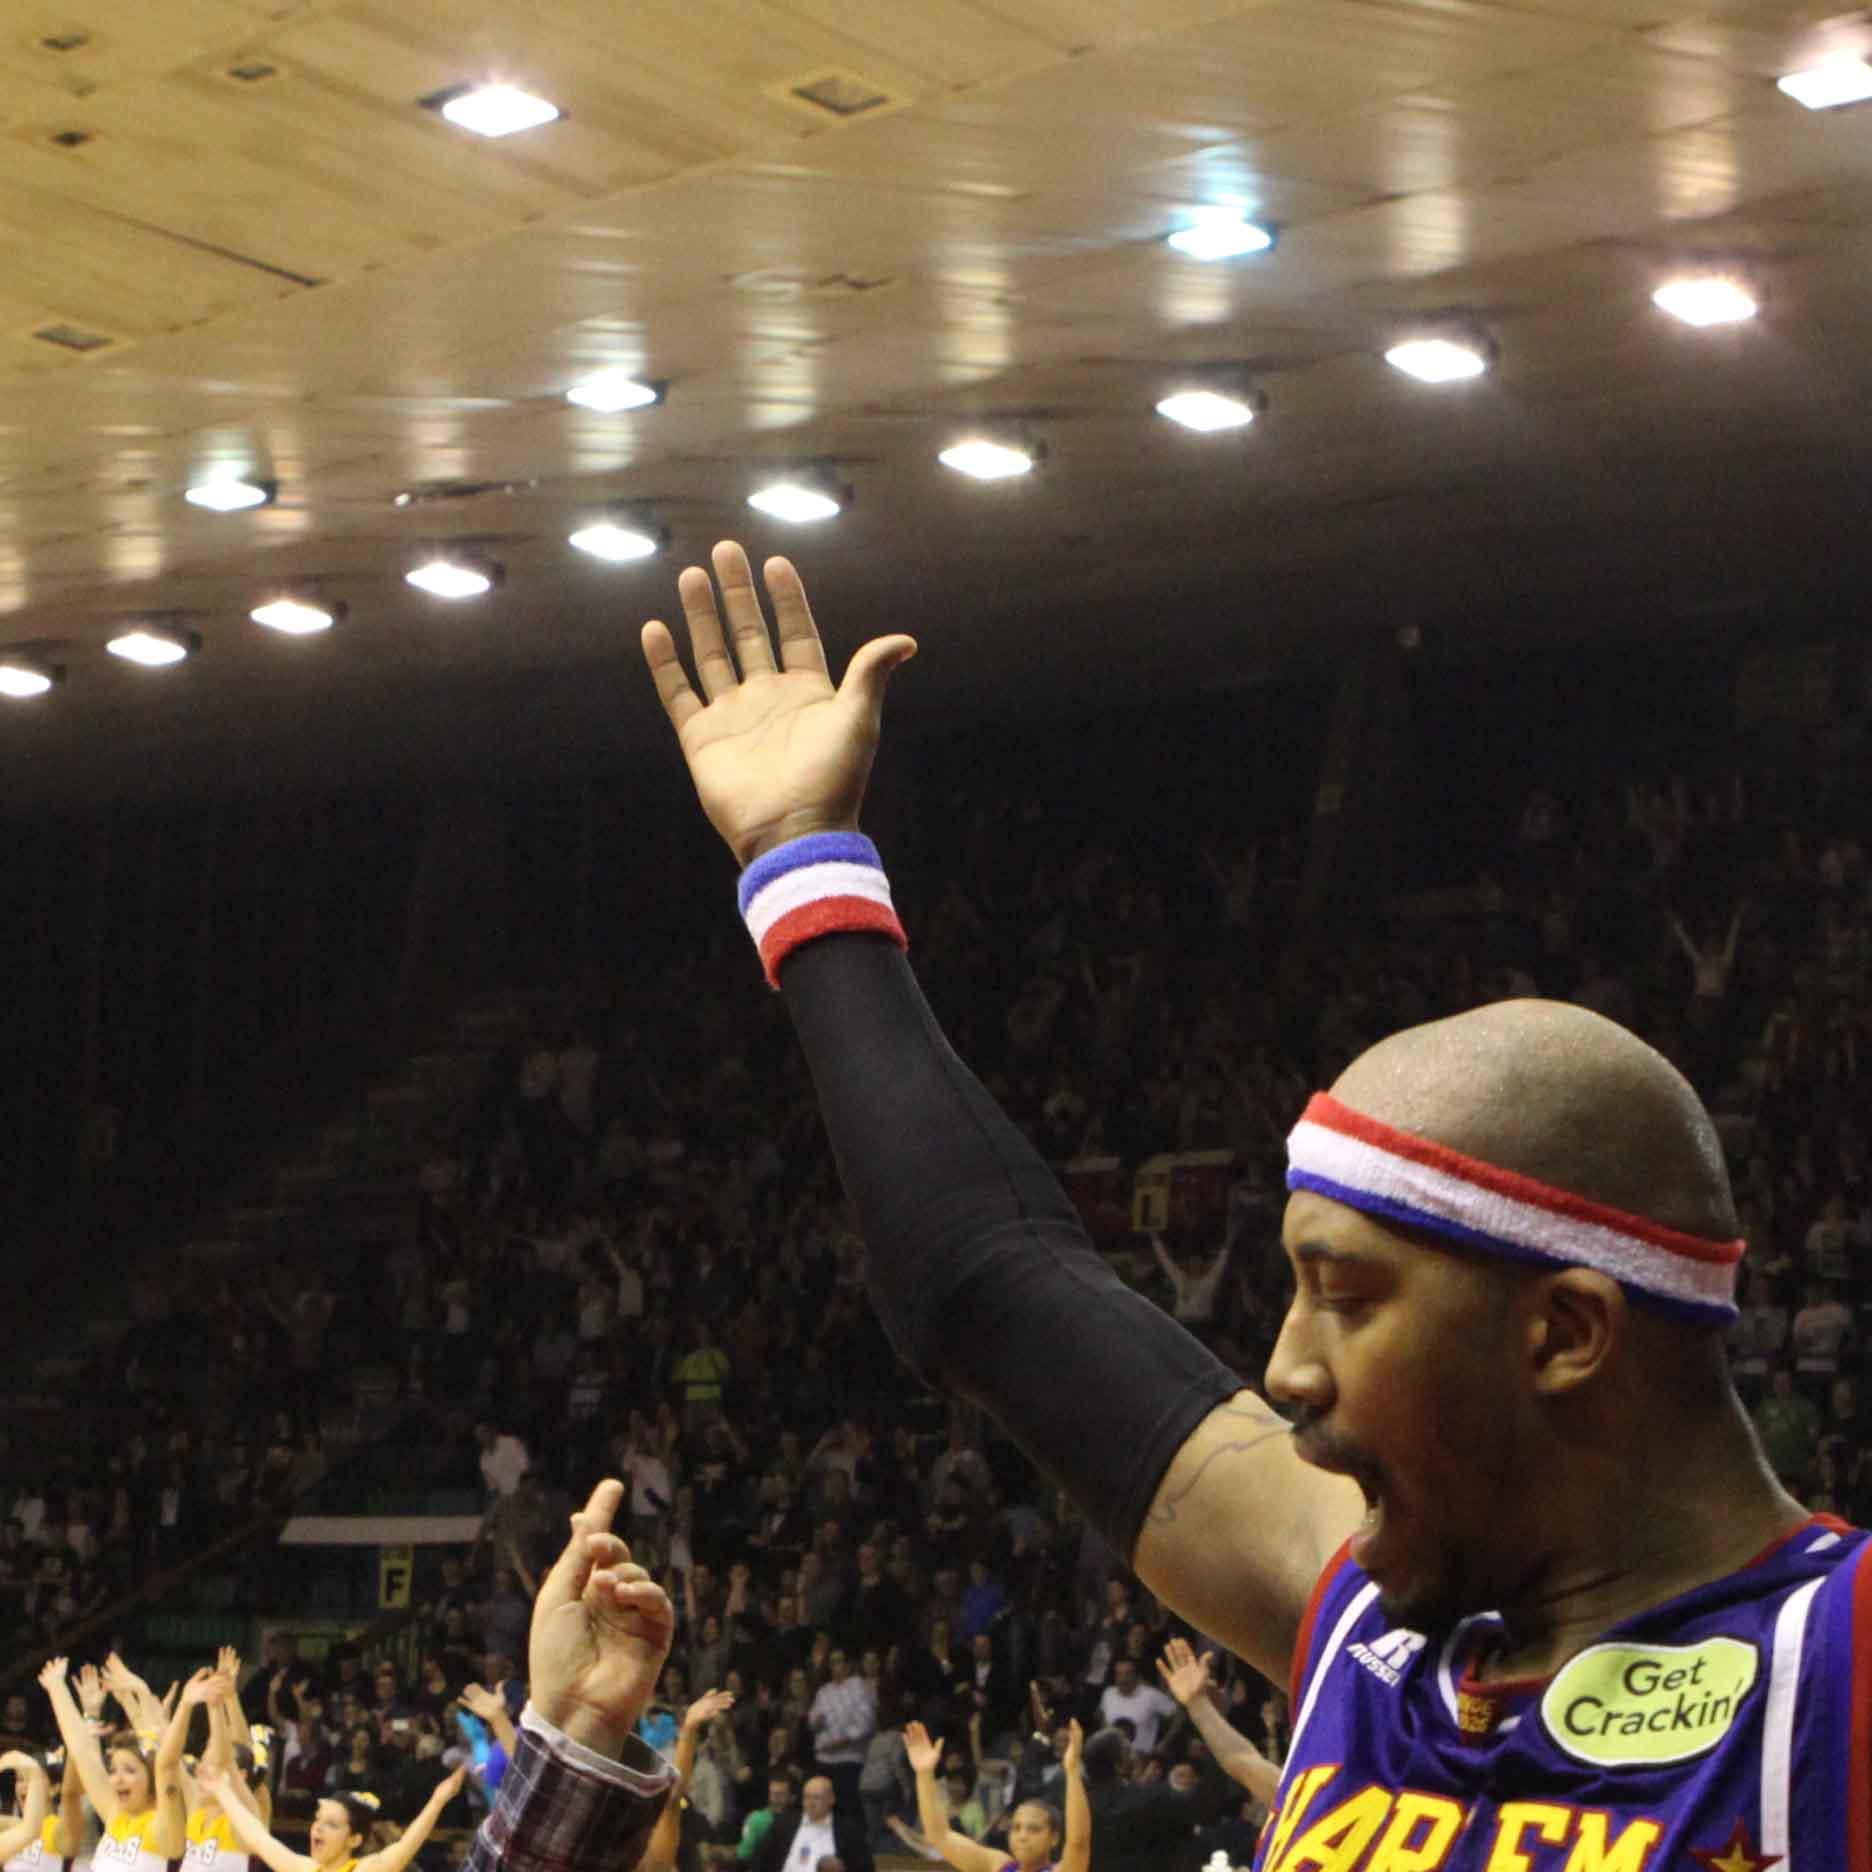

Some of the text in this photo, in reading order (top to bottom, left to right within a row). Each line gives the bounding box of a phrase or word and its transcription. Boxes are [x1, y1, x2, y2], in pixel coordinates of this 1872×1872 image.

[387, 1569, 405, 1602] F
[1622, 1656, 1705, 1698] Get
[1562, 1677, 1745, 1738] Crackin'
